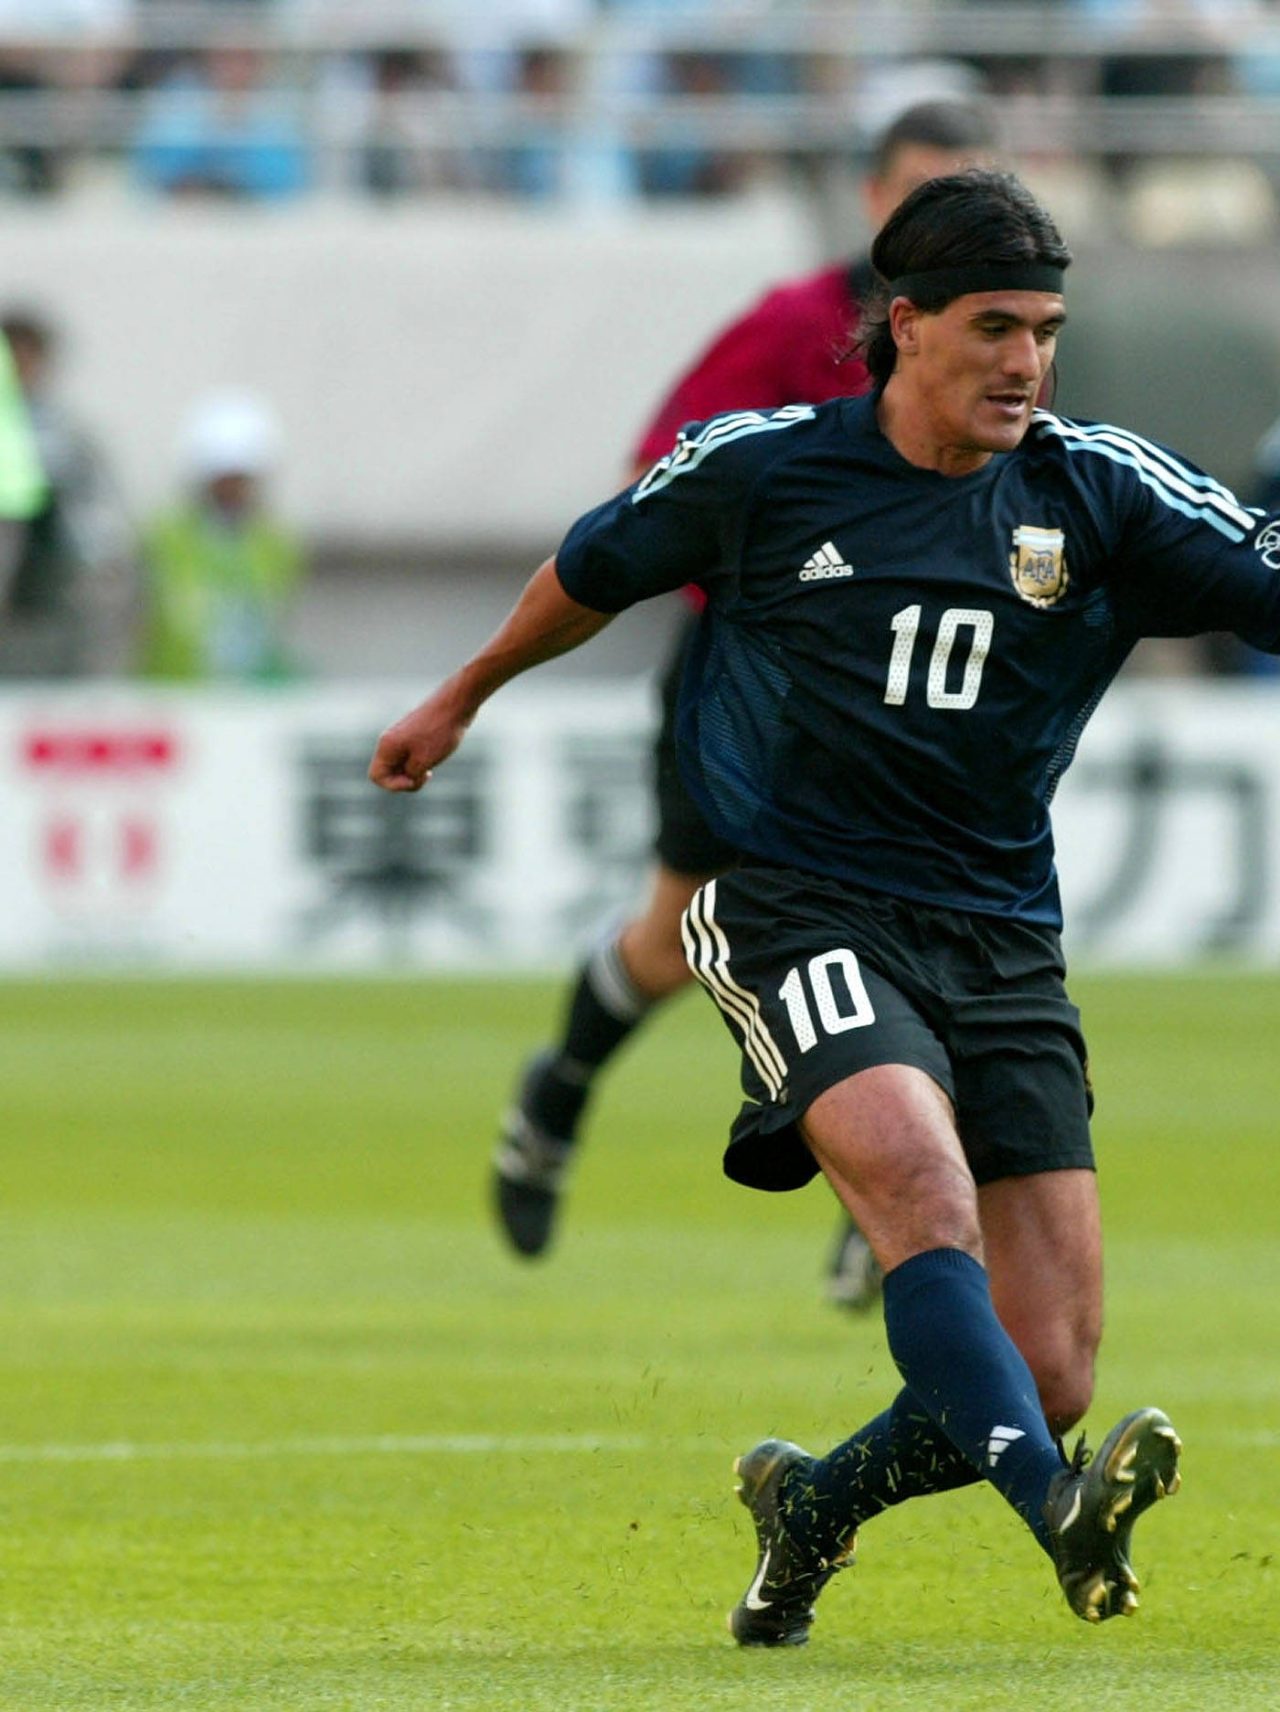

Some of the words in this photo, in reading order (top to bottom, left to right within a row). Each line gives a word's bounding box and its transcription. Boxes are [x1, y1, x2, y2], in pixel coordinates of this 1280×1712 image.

[799, 564, 854, 582] adidas
[884, 604, 995, 710] 10
[779, 948, 876, 1053] 10
